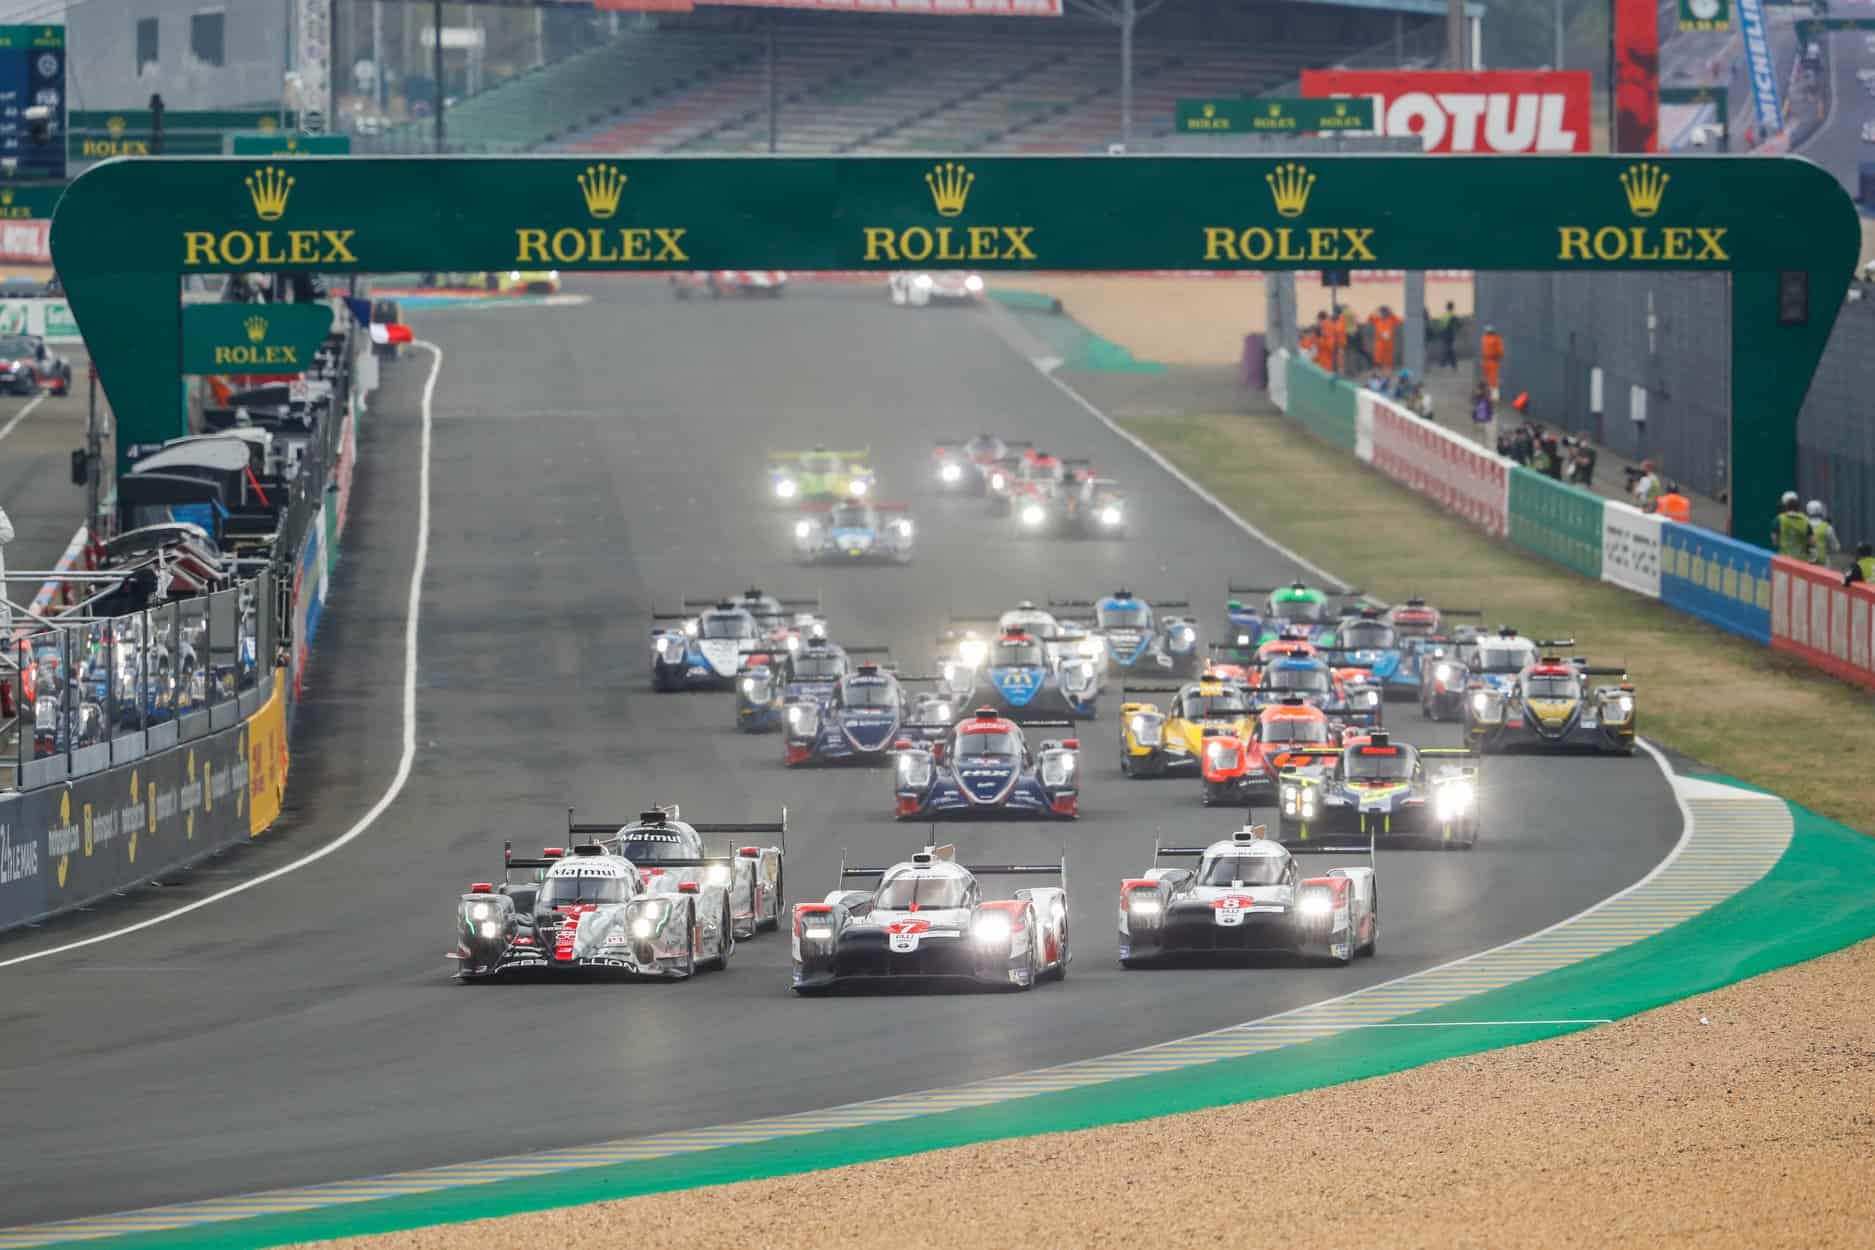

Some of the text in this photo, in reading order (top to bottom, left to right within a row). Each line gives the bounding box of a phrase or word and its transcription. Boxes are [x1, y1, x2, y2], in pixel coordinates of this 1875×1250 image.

[82, 140, 149, 157] ROLEX
[184, 229, 357, 264] ROLEX
[515, 228, 689, 263] ROLEX
[863, 226, 1036, 261] ROLEX
[1203, 227, 1377, 261] ROLEX
[1557, 226, 1729, 261] ROLEX
[215, 346, 298, 364] ROLEX
[1223, 899, 1240, 908] 8
[899, 923, 917, 934] 7
